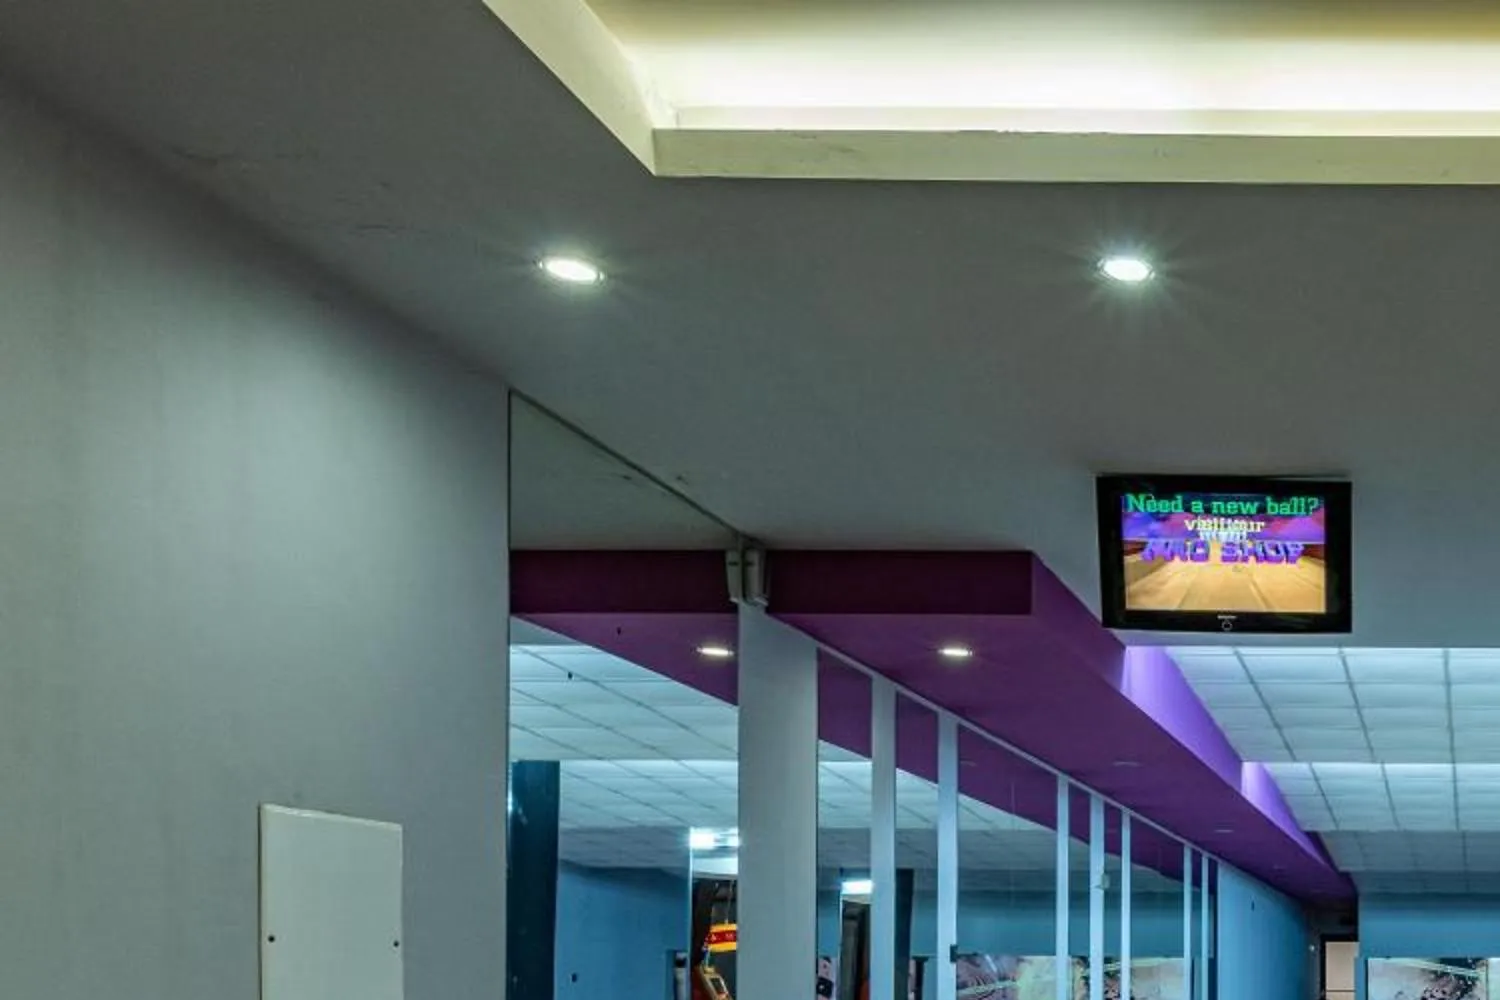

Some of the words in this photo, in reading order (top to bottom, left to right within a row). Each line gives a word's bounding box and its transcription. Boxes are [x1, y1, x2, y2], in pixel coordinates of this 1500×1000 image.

[1126, 494, 1184, 513] Need
[1191, 501, 1204, 513] a
[1211, 501, 1258, 515] new
[1266, 496, 1319, 515] ball?
